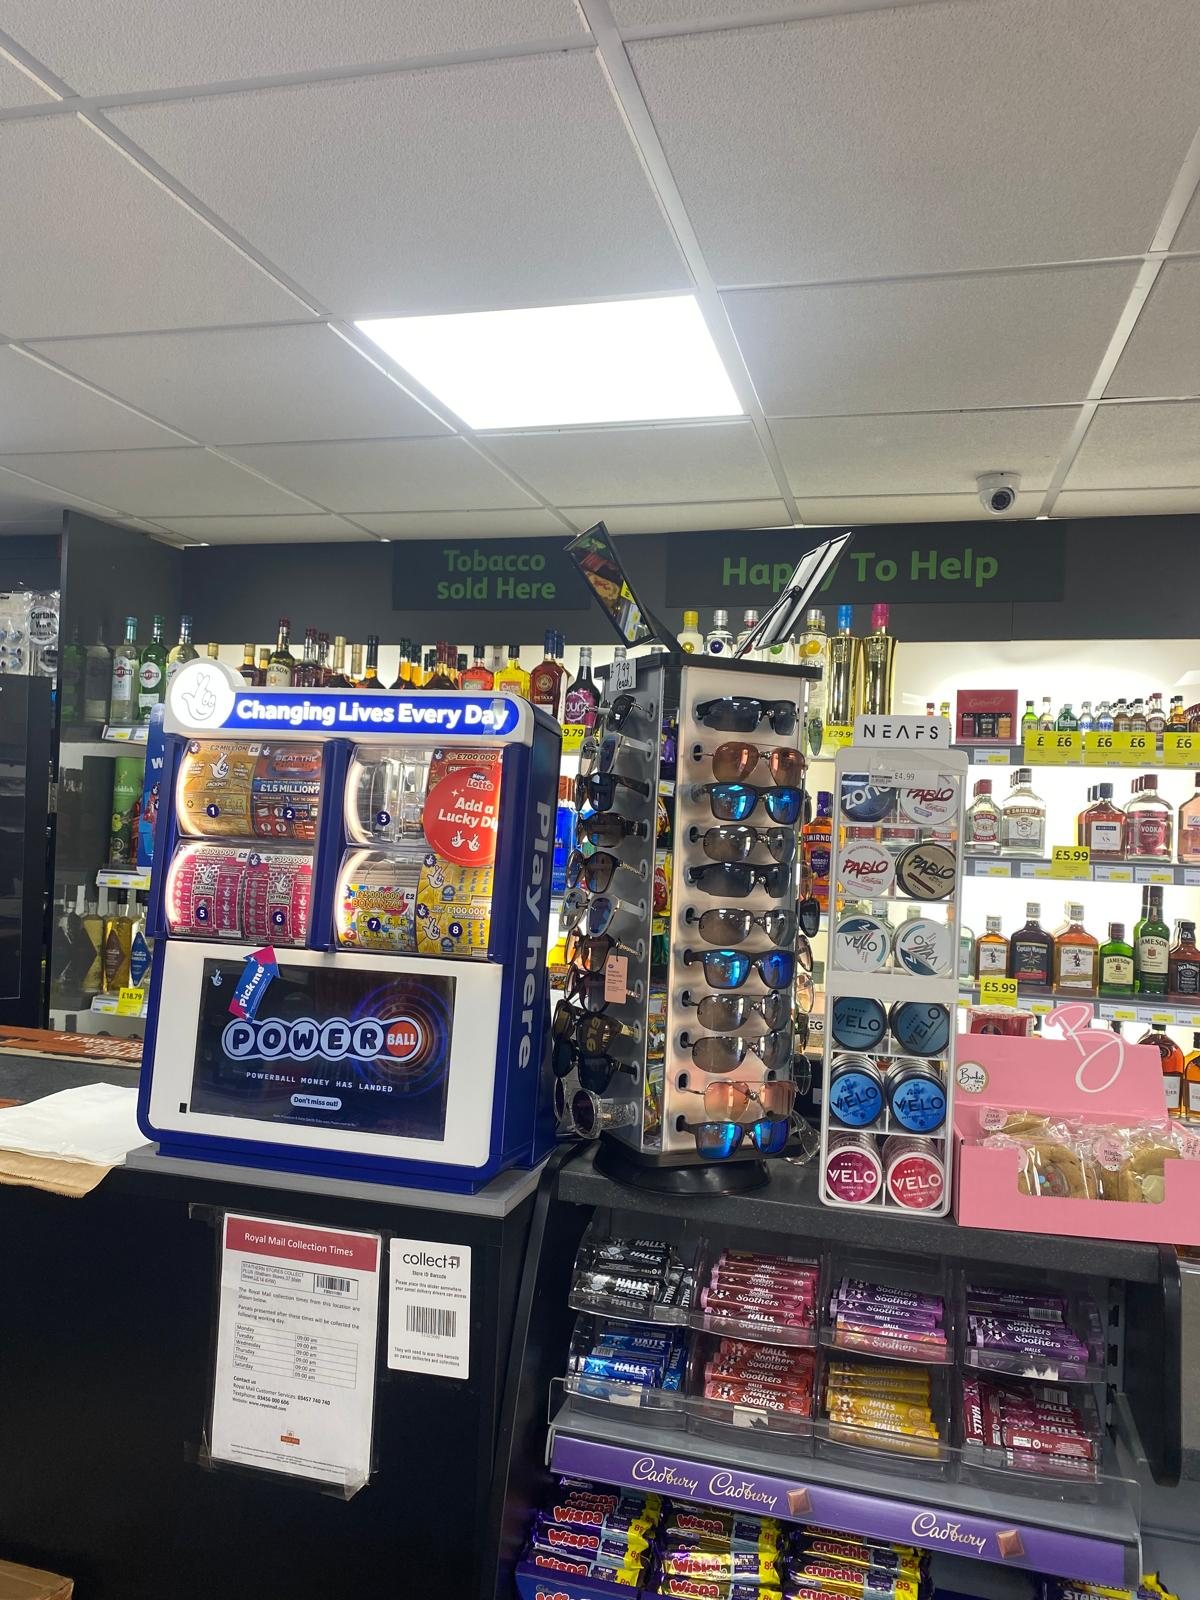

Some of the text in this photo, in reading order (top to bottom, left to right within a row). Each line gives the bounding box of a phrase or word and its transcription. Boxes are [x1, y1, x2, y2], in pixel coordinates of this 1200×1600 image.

[443, 548, 546, 572] Tobacco
[722, 549, 998, 592] Hap To Help
[437, 577, 556, 600] sold Here
[236, 699, 510, 730] Changing Lives Every Day
[828, 730, 853, 738] £29.9
[863, 724, 938, 739] NEAFS
[1057, 737, 1072, 747] £6
[1097, 737, 1112, 748] £6
[1130, 737, 1145, 748] £6
[1176, 738, 1192, 748] £6
[894, 773, 915, 781] £4.99
[260, 785, 321, 794] £1.5 MILLION?
[467, 779, 493, 791] Lotto
[455, 797, 494, 814] Add a
[286, 810, 292, 818] 2
[380, 815, 387, 823] 3
[438, 809, 480, 829] Lucky
[526, 802, 549, 923] Play
[1055, 850, 1088, 861] £5.99
[843, 858, 888, 879] PABLO
[908, 854, 955, 880] PABLO
[276, 914, 282, 922] 6
[371, 920, 377, 929] 7
[452, 926, 459, 934] 8
[983, 982, 1017, 993] £5.99
[121, 992, 142, 1000] £18.79
[239, 983, 255, 1007] Pick
[518, 935, 542, 1069] here
[834, 1012, 880, 1031] VELO
[906, 1007, 941, 1046] VELO
[232, 1027, 416, 1050] POWER BALL
[246, 1072, 393, 1093] POWERBALL MONEY HAS LANDED
[293, 1096, 310, 1104] Don't
[832, 1086, 878, 1111] VELO
[895, 1096, 943, 1112] VELO
[828, 1169, 876, 1183] VELO
[892, 1174, 941, 1190] VELO
[245, 1232, 353, 1257] Royal Mail Collection Times
[635, 1240, 666, 1248] HALLS
[630, 1251, 662, 1262] HALLS
[615, 1277, 649, 1292] HALLS
[662, 1285, 676, 1304] HALLS
[736, 1294, 779, 1306] Soothers
[874, 1295, 917, 1307] Soothers
[748, 1313, 775, 1323] HALLS
[867, 1305, 910, 1317] Soothers
[236, 1332, 254, 1340] Tuesday
[237, 1325, 255, 1333] Monday
[1007, 1323, 1051, 1336] Soothers
[1014, 1335, 1060, 1348] Soothers
[236, 1347, 255, 1355] Thursday
[670, 1347, 680, 1369] HALLS
[234, 1361, 253, 1370] Saturday
[614, 1362, 647, 1376] HALLS
[740, 1371, 782, 1384] Soothers
[741, 1394, 785, 1410] Soothers
[869, 1400, 896, 1410] HALLS
[860, 1406, 905, 1420] Soothers
[971, 1405, 983, 1435] HALLS
[631, 1457, 778, 1507] Cadbury Cadbury
[554, 1506, 603, 1525] Wispa
[677, 1514, 724, 1533] Wispa
[548, 1529, 599, 1549] Wispa
[911, 1512, 987, 1554] Cadbury
[813, 1541, 869, 1560] crunchie
[805, 1566, 863, 1583] crunchie
[670, 1580, 720, 1598] Wispa
